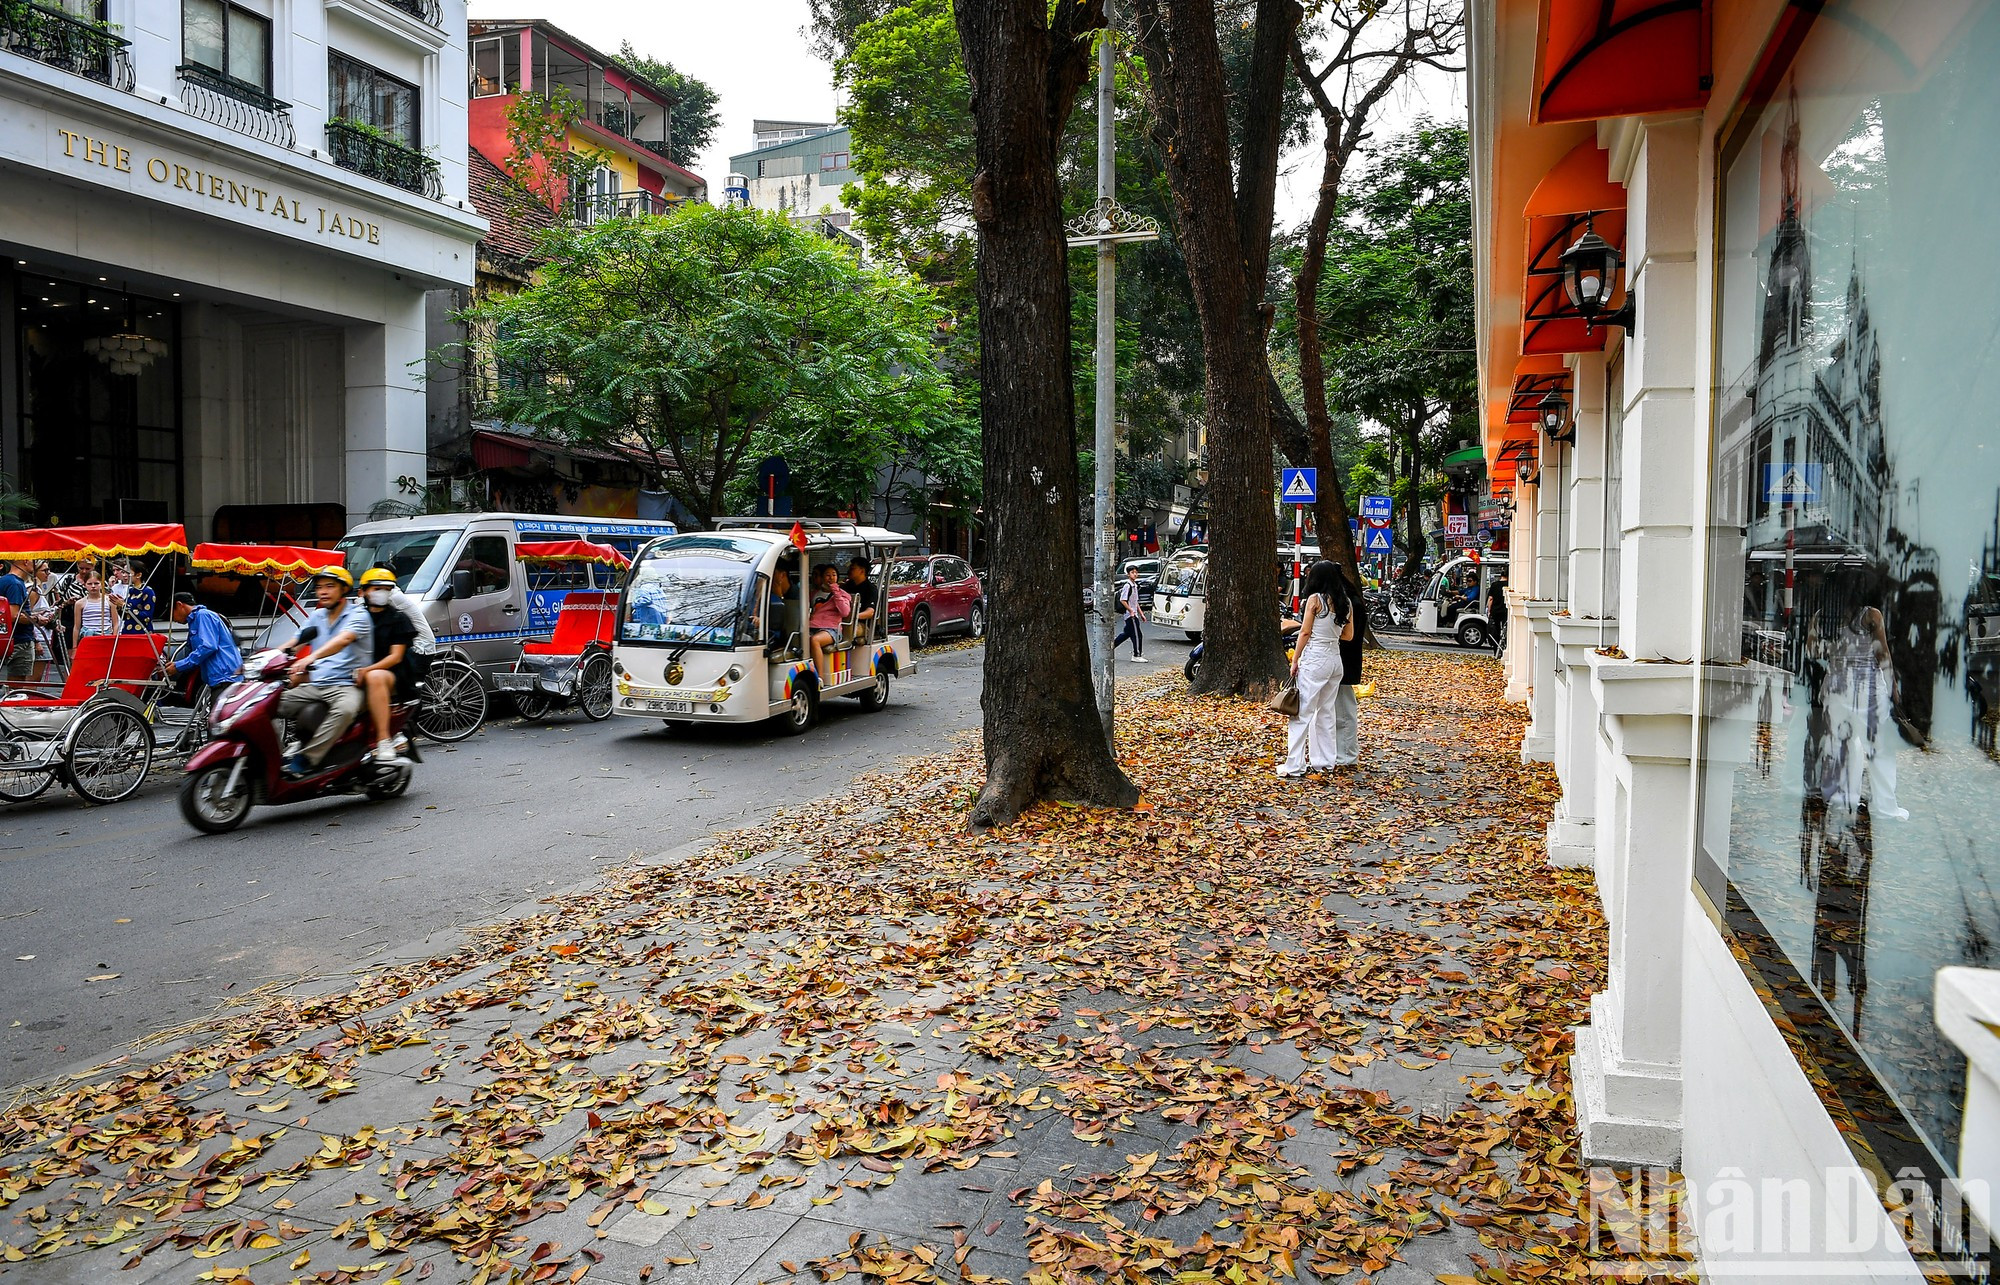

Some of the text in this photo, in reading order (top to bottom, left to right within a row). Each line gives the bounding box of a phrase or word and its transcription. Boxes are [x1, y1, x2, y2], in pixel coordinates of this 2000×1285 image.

[58, 128, 380, 245] THE ORIENTAL JADE
[398, 475, 417, 494] 92
[1455, 536, 1464, 547] 69
